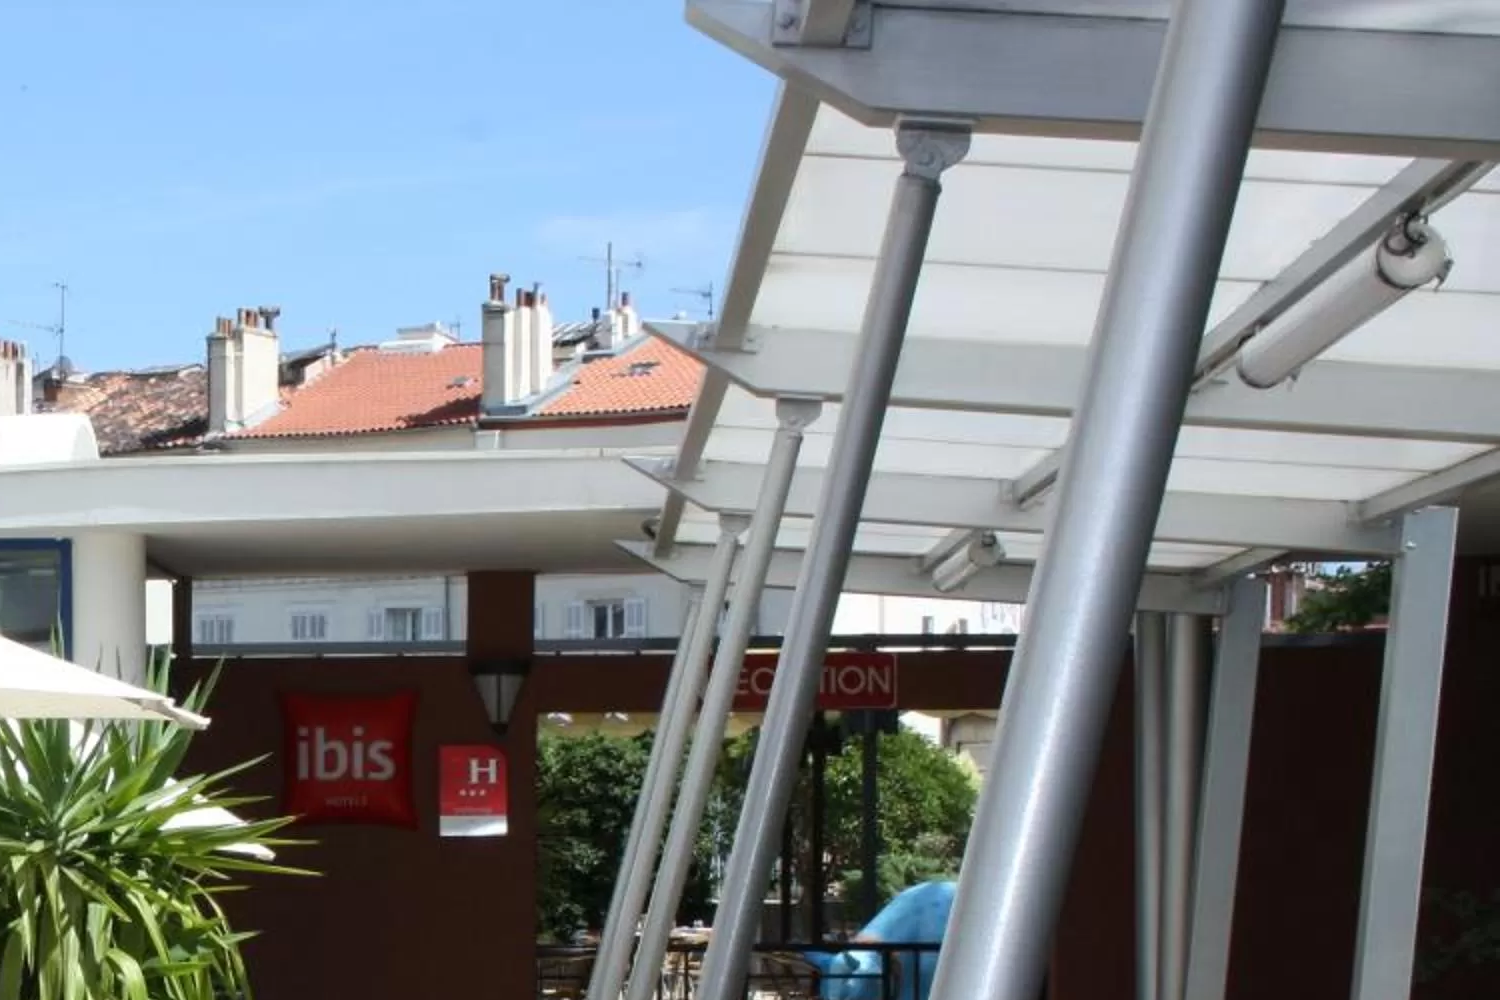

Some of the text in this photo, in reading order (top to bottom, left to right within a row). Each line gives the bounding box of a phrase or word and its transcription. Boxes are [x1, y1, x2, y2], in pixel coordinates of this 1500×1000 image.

[720, 664, 892, 695] ECTION
[296, 726, 396, 781] ibis
[468, 758, 498, 785] H
